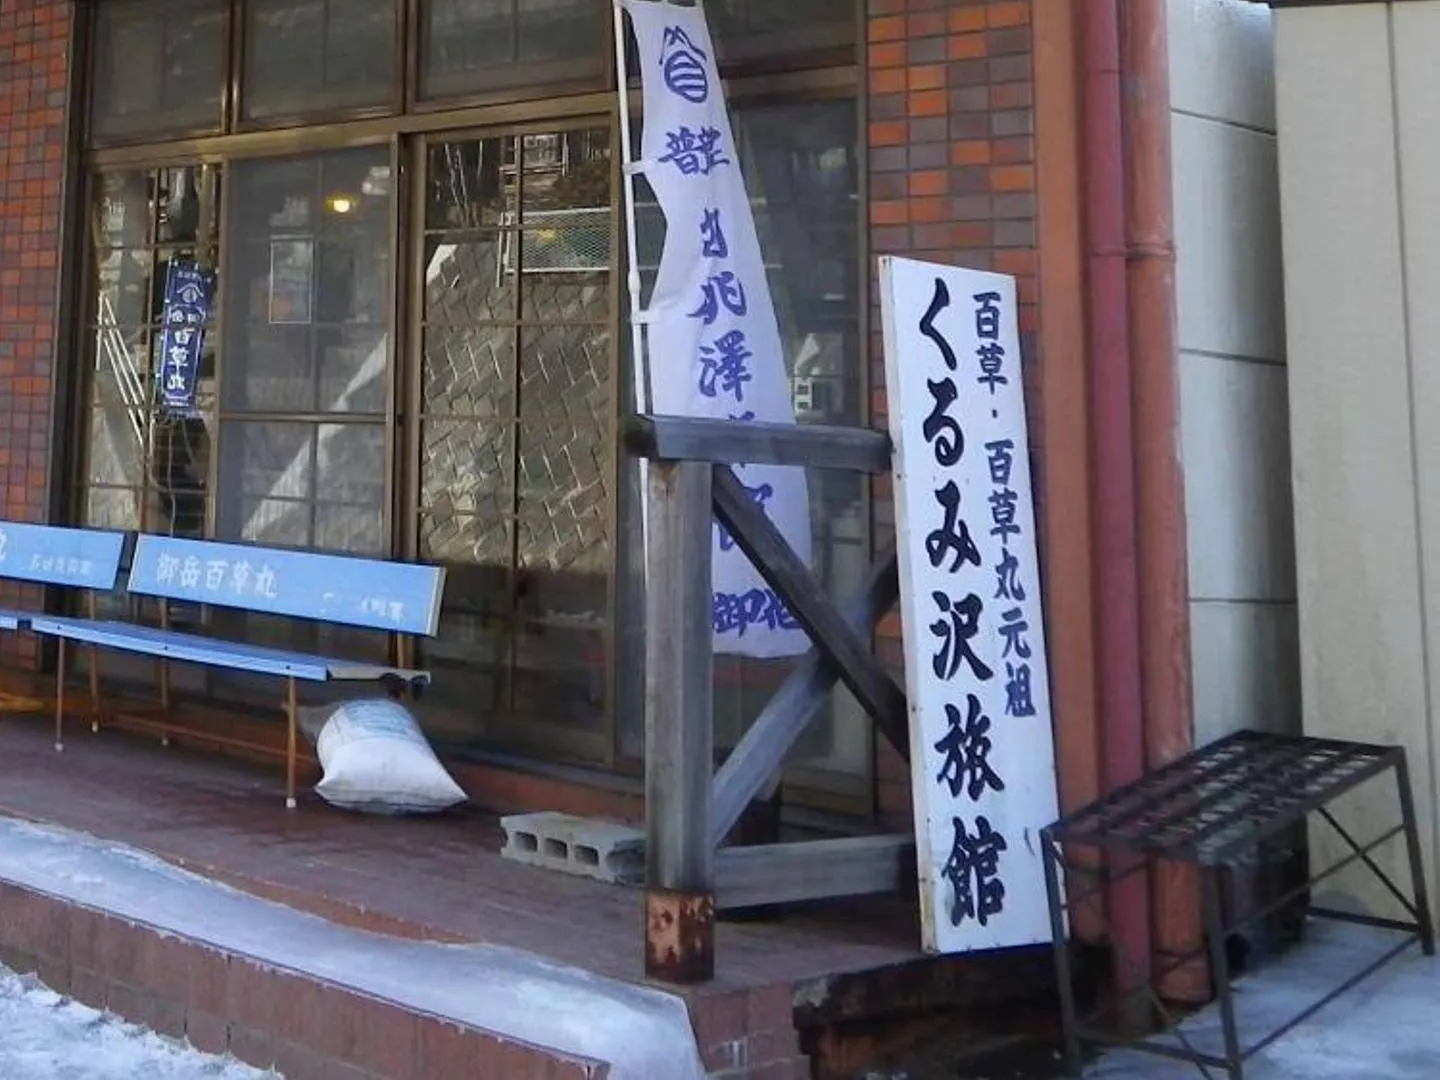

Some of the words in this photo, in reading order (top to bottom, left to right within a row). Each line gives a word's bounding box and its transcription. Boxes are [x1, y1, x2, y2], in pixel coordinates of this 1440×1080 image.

[919, 276, 1008, 926] くるみ沢旅館
